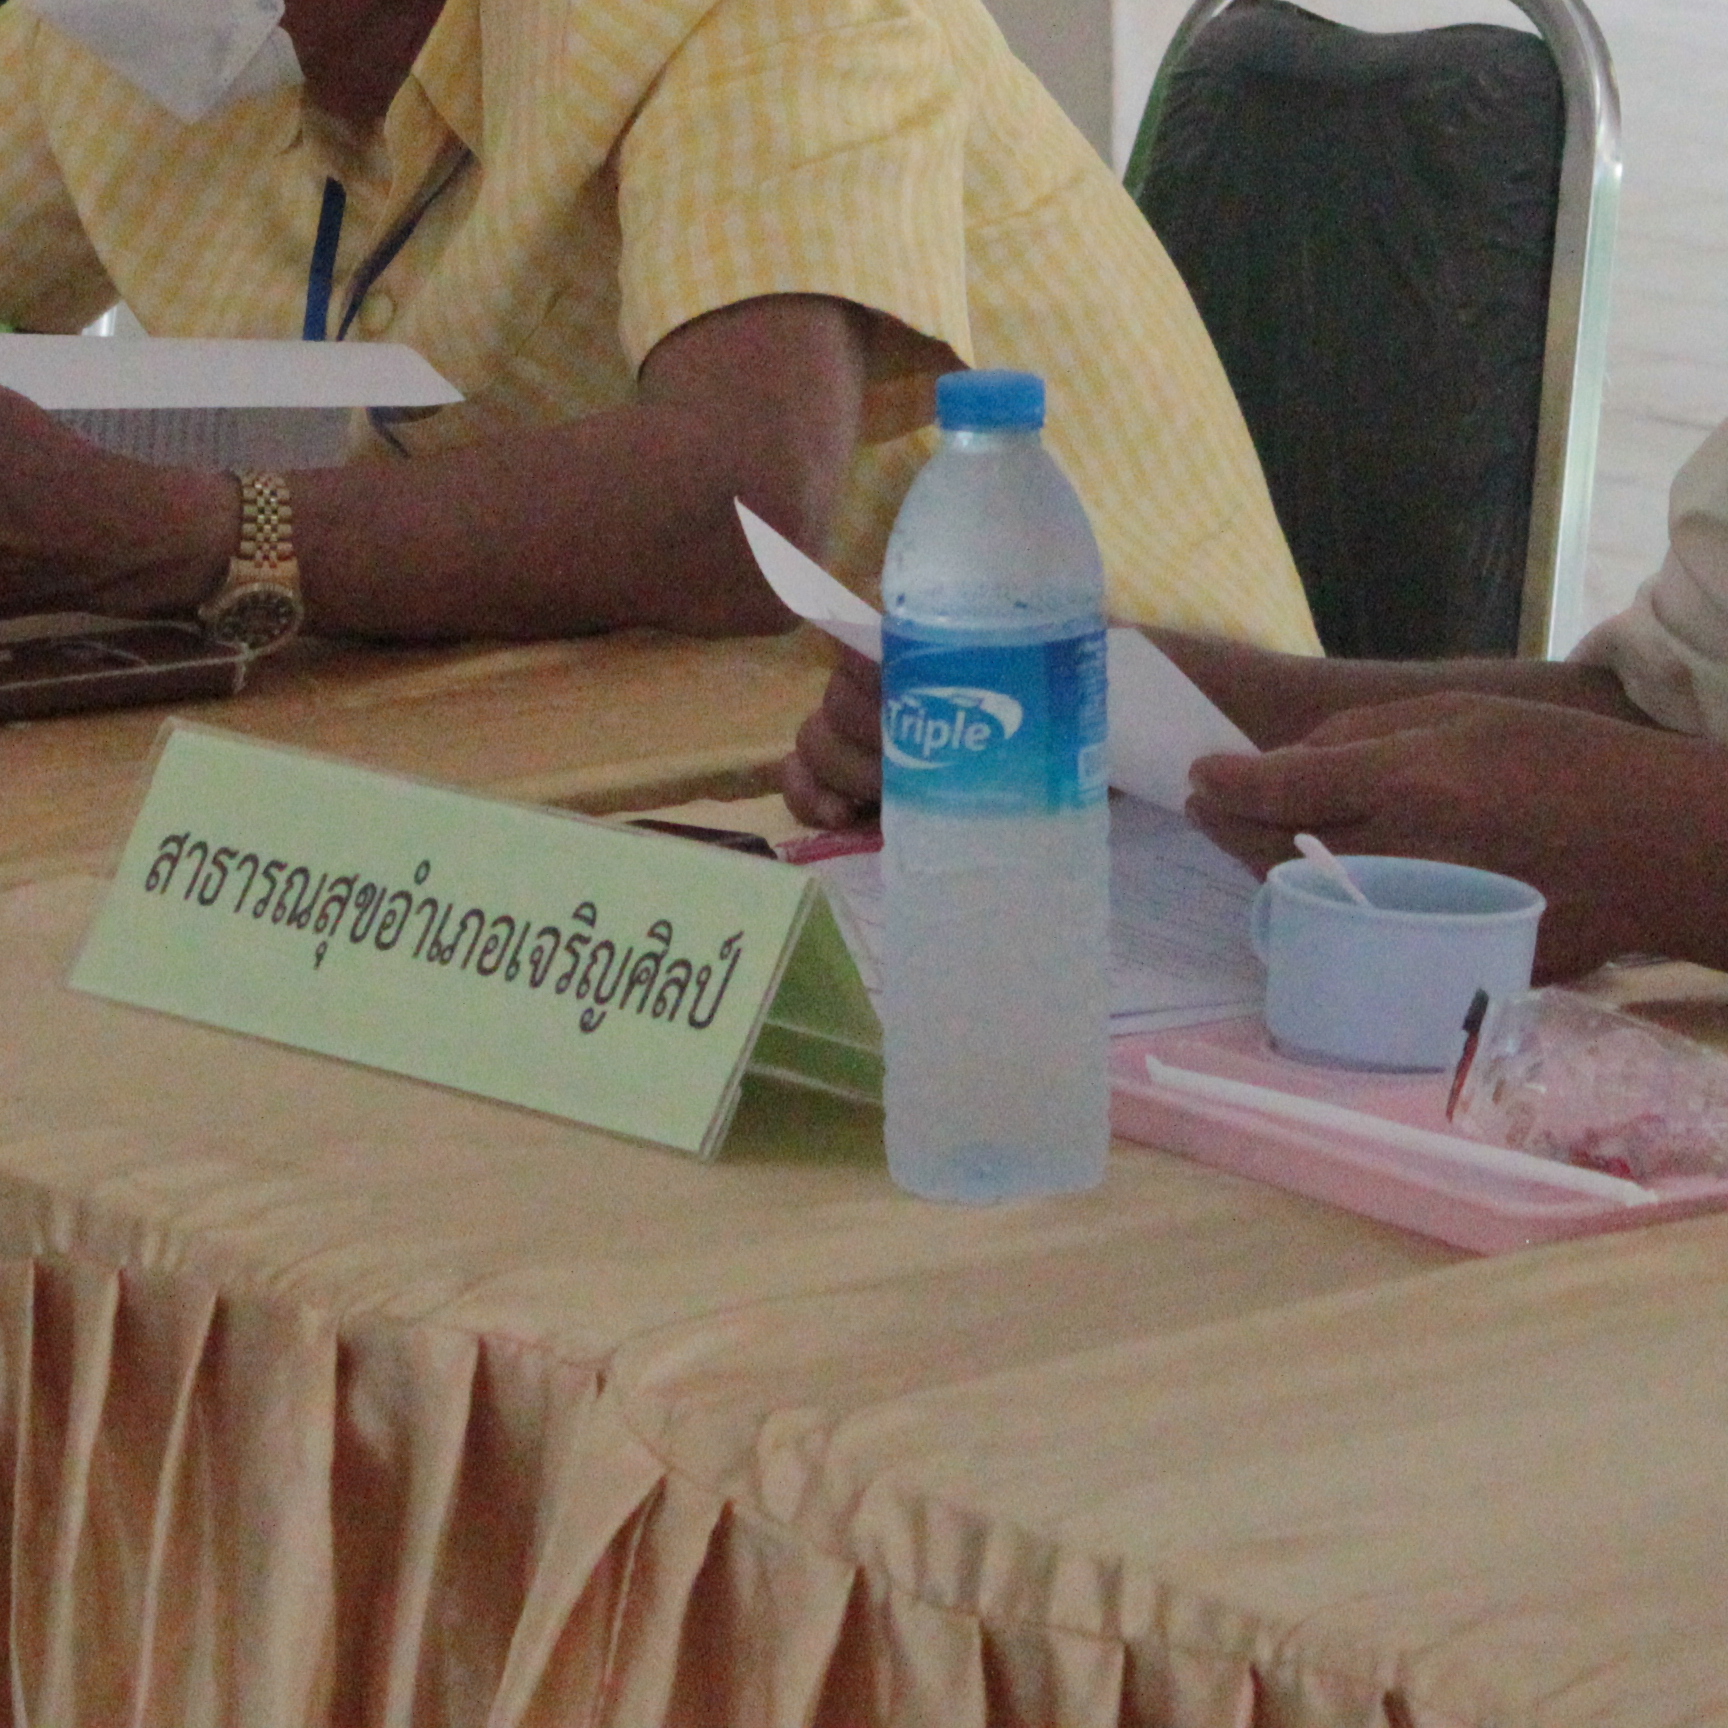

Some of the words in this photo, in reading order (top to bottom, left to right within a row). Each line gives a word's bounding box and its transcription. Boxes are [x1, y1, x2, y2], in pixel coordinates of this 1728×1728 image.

[144, 830, 745, 1033] สาธารณสุขอำเภอเจริญศิลป์
